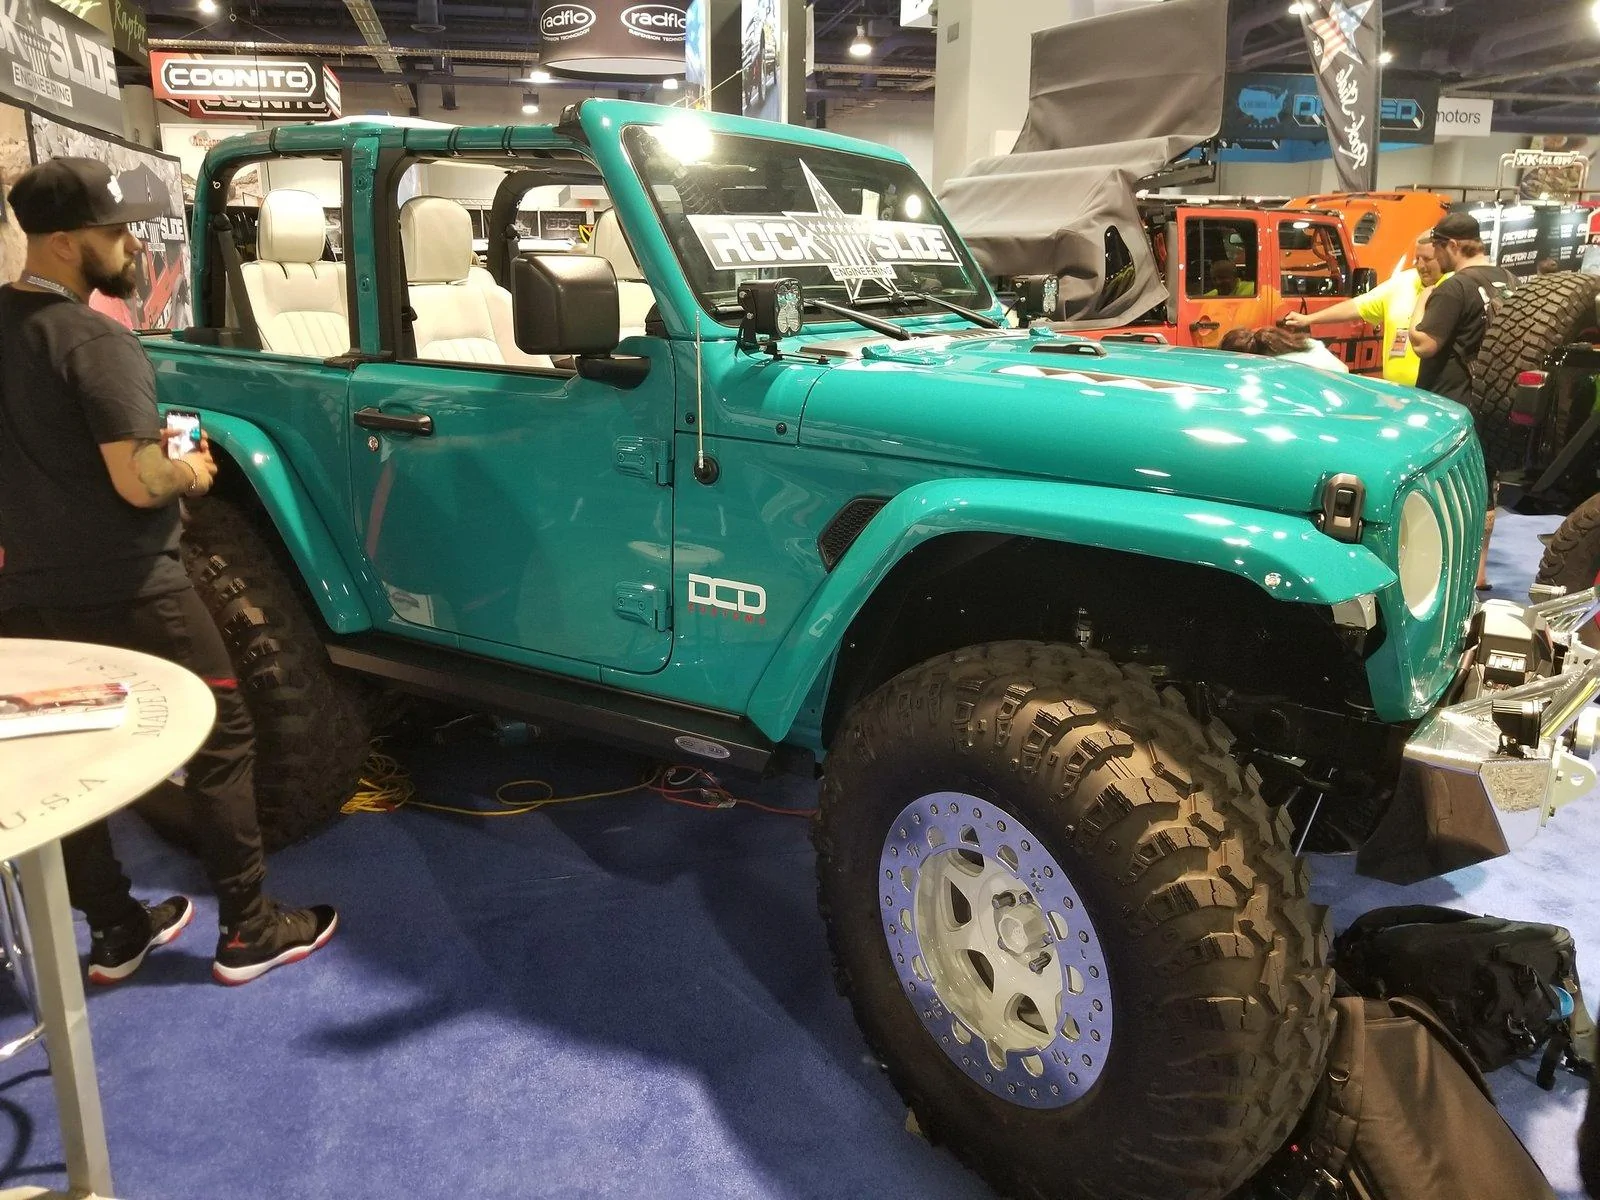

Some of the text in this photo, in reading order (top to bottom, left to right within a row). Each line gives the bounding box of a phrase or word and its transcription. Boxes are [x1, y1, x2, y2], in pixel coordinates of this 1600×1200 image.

[543, 10, 589, 29] radflo
[41, 16, 121, 101] SLIDE
[14, 66, 71, 102] ENGINEERING
[168, 68, 309, 88] COGNITO
[160, 217, 184, 241] SLIDE
[703, 221, 955, 263] ROCK SLIDE
[832, 266, 894, 278] ENGINEERING
[131, 696, 168, 737] MADE
